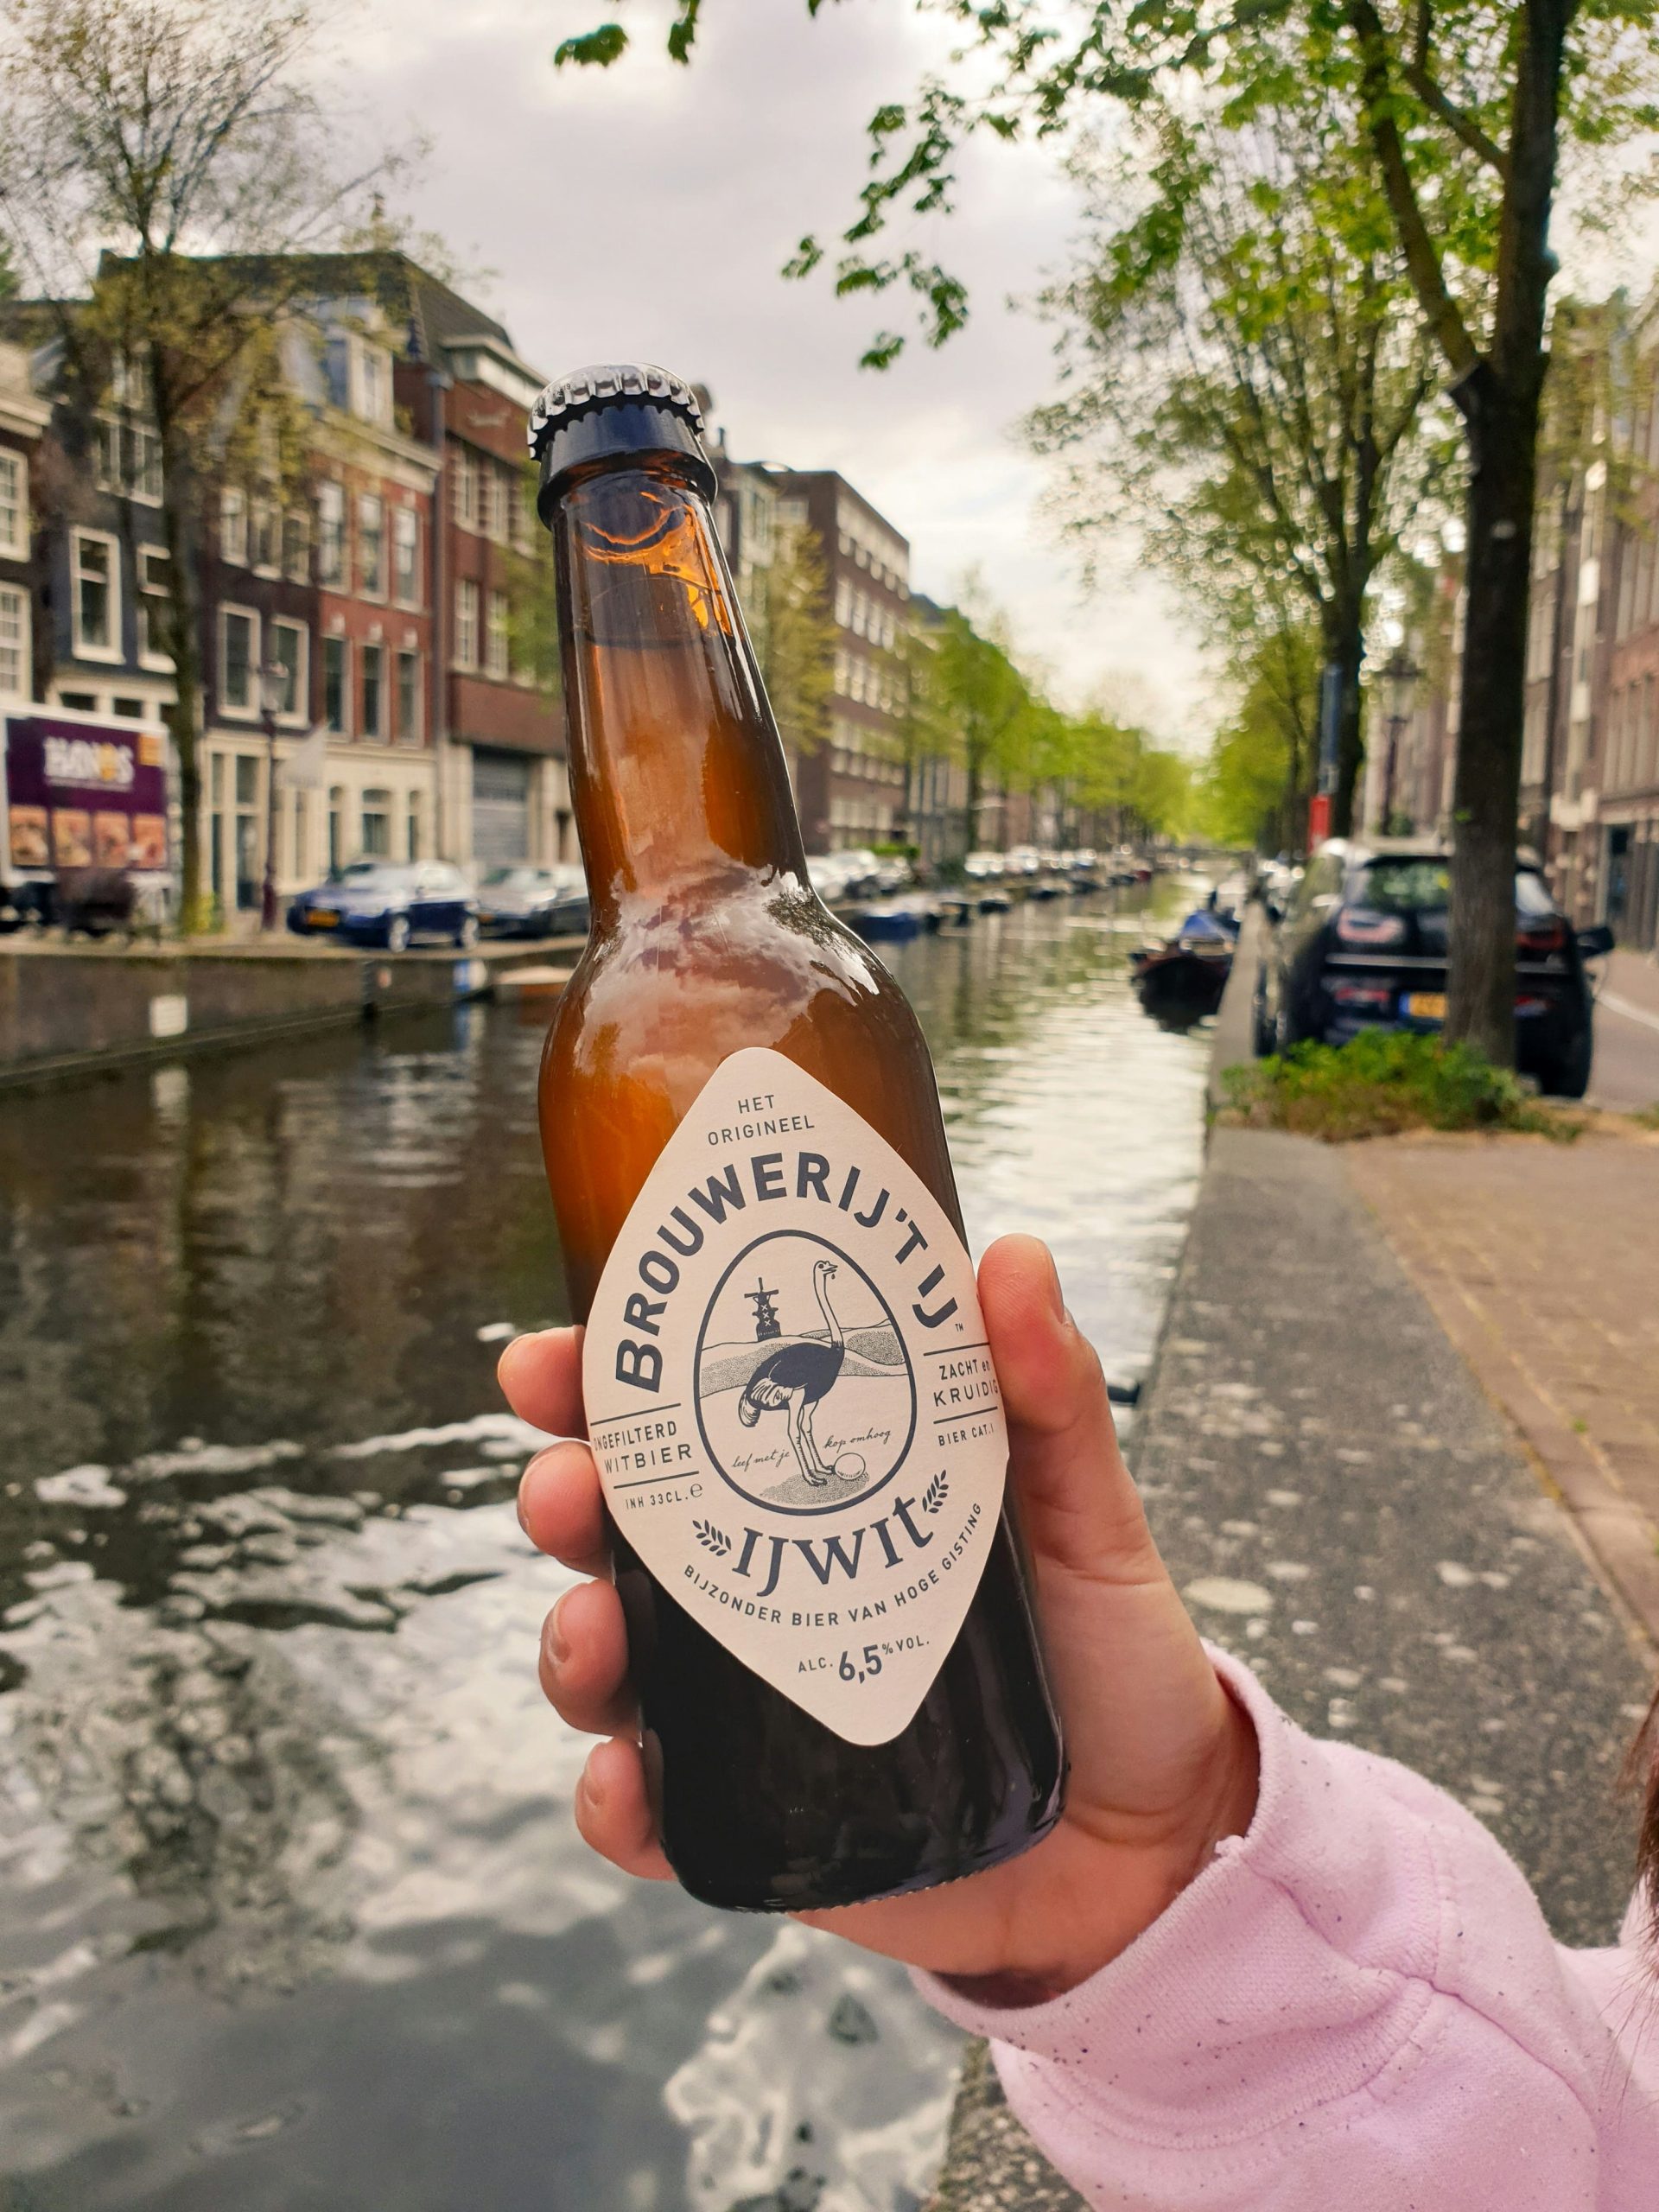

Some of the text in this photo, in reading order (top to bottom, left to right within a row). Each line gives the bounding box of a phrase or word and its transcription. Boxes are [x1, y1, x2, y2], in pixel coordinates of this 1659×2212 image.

[737, 1094, 775, 1114] HET
[708, 1115, 815, 1146] ORIGINEEL
[938, 1359, 979, 1381] ZACHT
[933, 1379, 998, 1408] KRUIDIG
[823, 1427, 892, 1453] kop omhoog
[938, 1429, 968, 1446] BIER
[604, 1443, 692, 1474] WITBIER
[753, 1450, 779, 1464] met
[775, 1448, 791, 1468] je
[625, 1496, 645, 1510] INH
[683, 1502, 982, 1627] BIJZONDER BIER VAN HOGE GISTING
[798, 1656, 834, 1674] ALC.
[895, 1634, 930, 1652] VOL.
